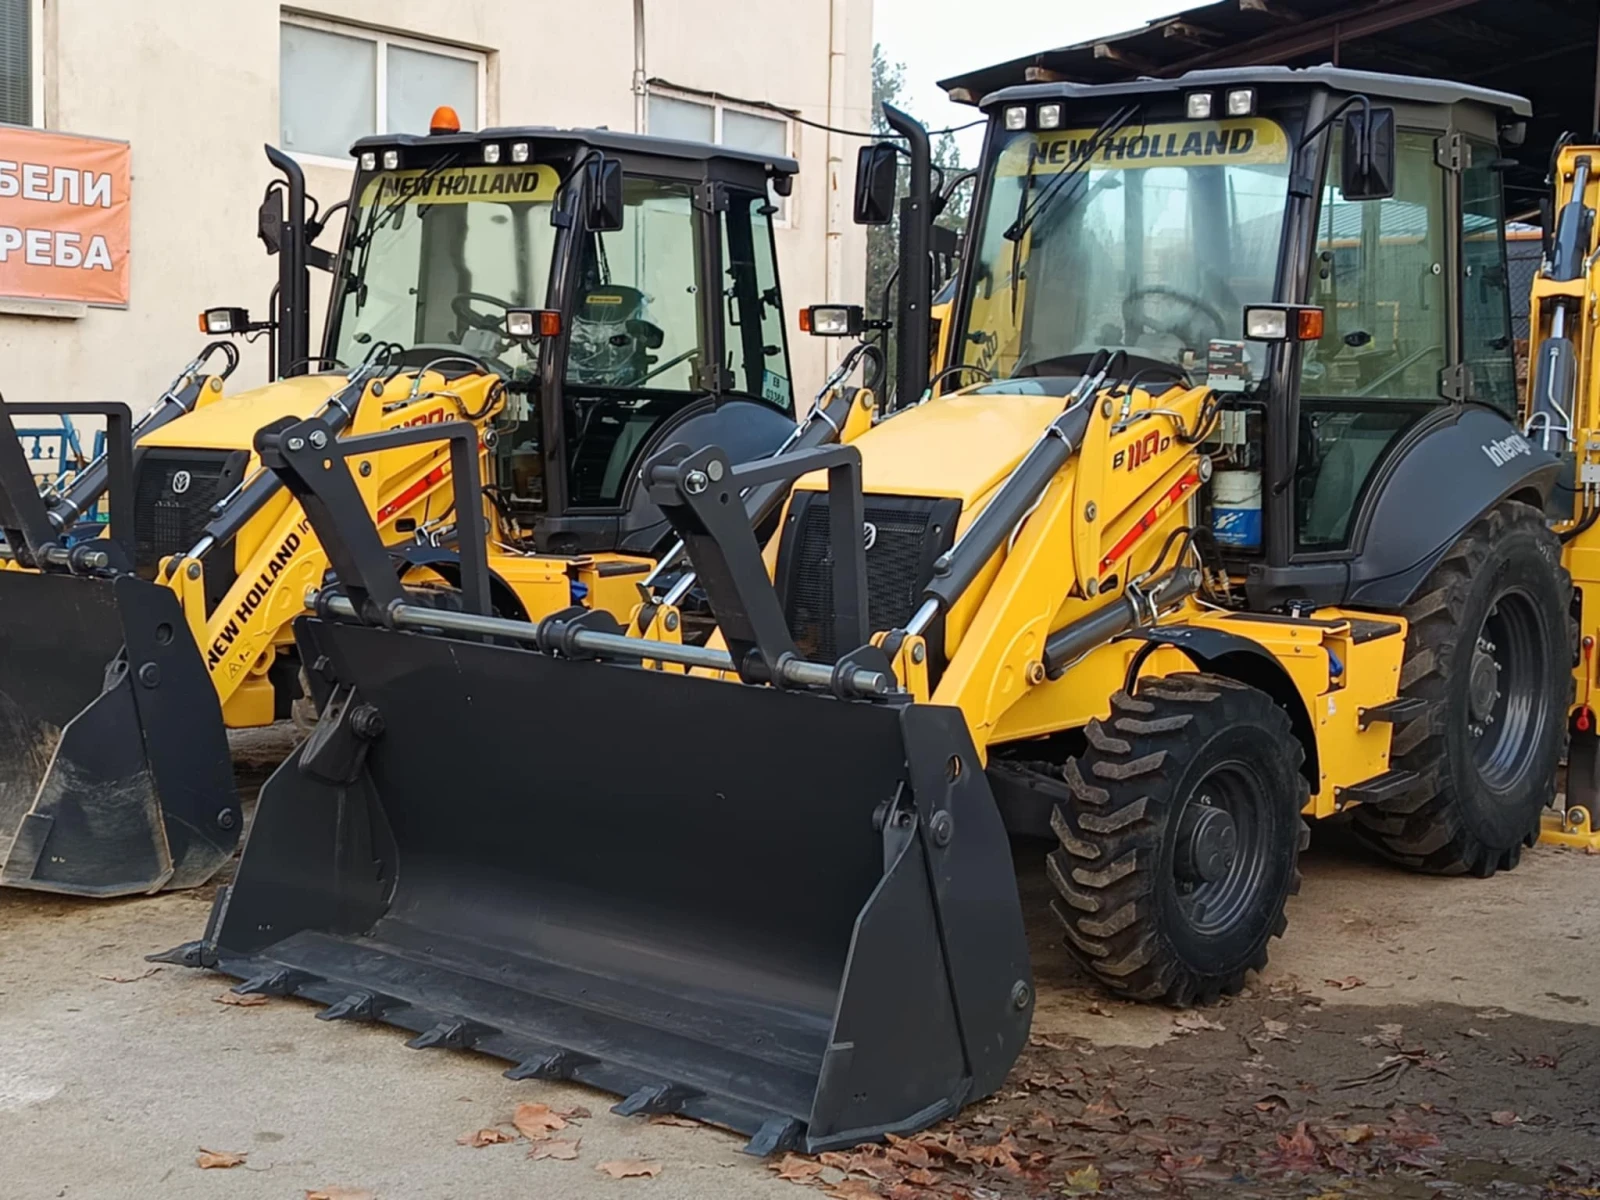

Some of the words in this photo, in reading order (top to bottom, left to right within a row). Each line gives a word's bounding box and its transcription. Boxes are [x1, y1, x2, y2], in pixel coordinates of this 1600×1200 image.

[1027, 138, 1095, 165] NEW
[1103, 128, 1254, 161] HOLLAND
[384, 174, 434, 198] NEW
[437, 172, 540, 197] HOLLAND
[208, 618, 240, 671] NEW
[235, 532, 301, 624] HOLLAND
